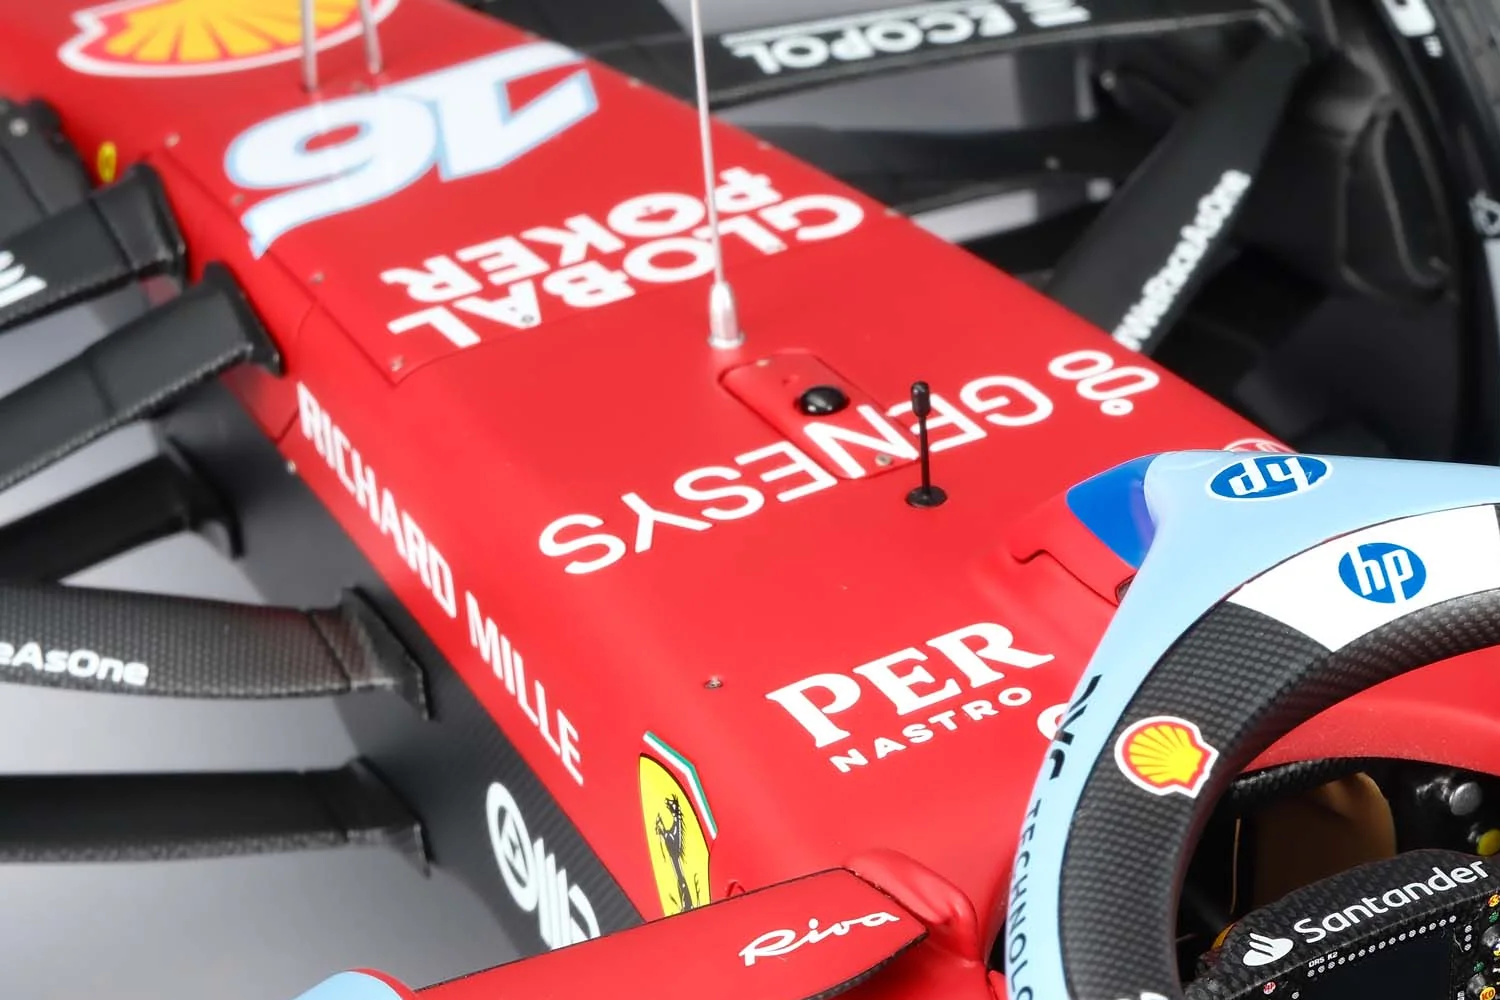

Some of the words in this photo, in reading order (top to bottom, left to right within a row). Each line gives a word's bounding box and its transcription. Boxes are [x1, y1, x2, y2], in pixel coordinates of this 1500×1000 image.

[732, 2, 1017, 74] ECOPOL
[223, 41, 599, 259] 16
[380, 167, 783, 302] POKER
[387, 194, 865, 349] GLOBAL
[538, 375, 1054, 575] GENESYS
[297, 381, 457, 618] RICHARD
[466, 591, 583, 786] MILLE
[1341, 544, 1422, 604] hp
[829, 688, 1032, 773] NASTRO
[739, 912, 900, 967] Riva
[1293, 860, 1489, 944] Santander
